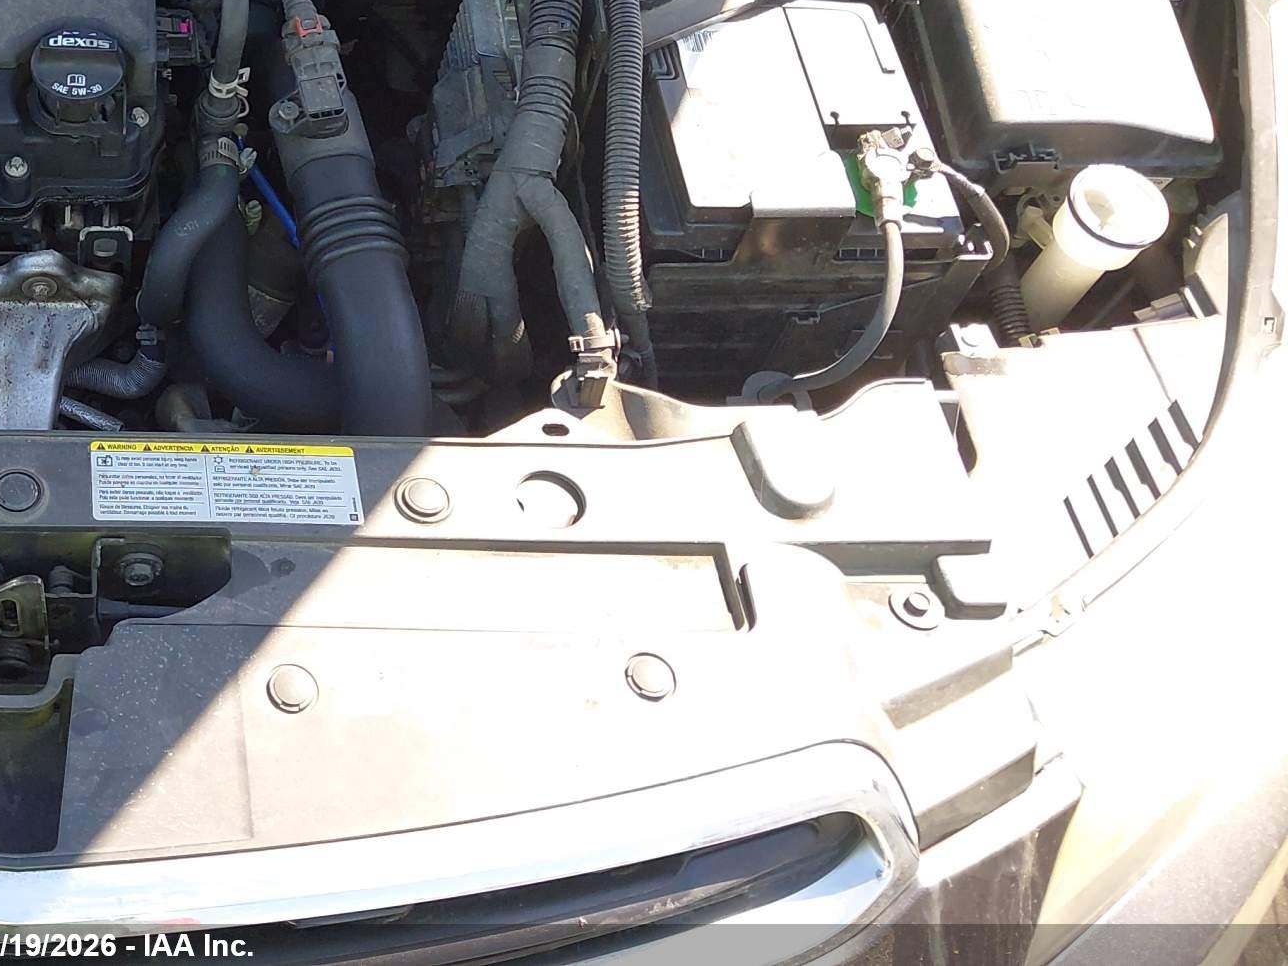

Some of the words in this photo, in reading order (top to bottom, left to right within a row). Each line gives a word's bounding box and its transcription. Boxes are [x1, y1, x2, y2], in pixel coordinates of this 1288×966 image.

[49, 35, 112, 48] dexos
[52, 83, 69, 94] SAE
[72, 84, 103, 96] 5W-30
